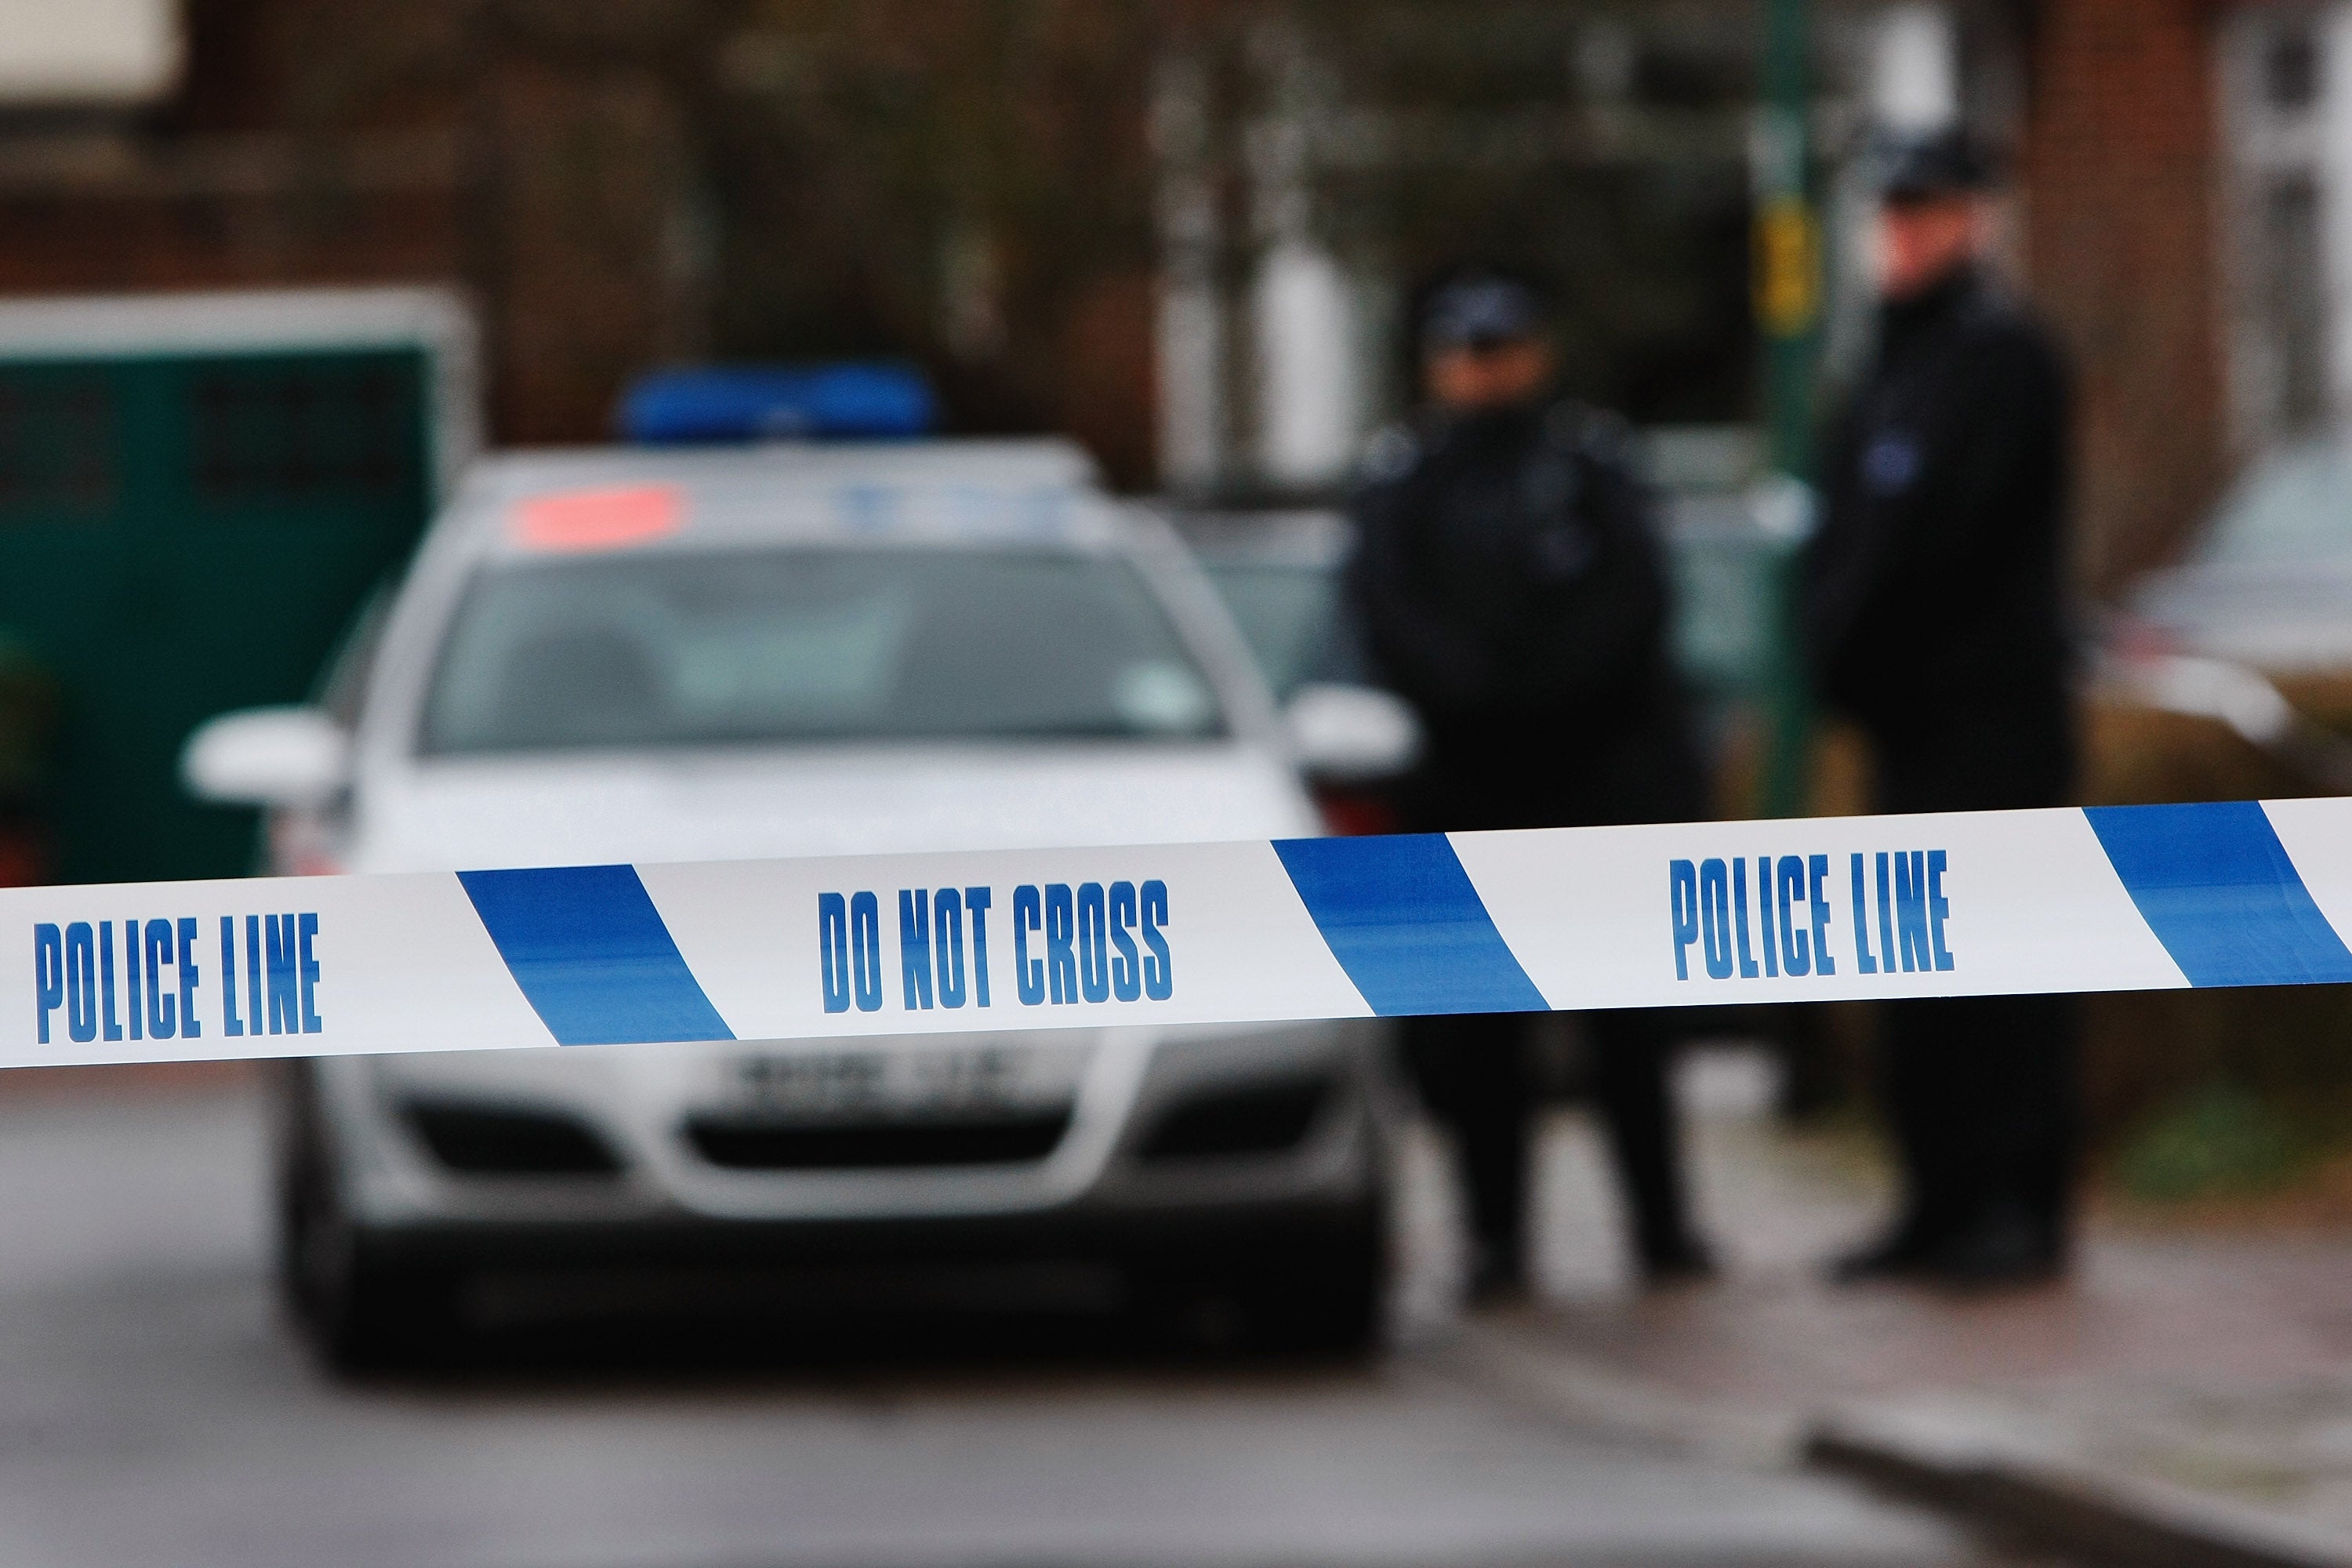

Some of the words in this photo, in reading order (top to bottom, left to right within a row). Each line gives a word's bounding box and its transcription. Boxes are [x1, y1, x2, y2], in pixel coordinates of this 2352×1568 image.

[34, 916, 201, 1044] POLICE
[220, 912, 323, 1036] LINE
[818, 890, 884, 1013] DO
[898, 885, 992, 1010] NOT
[1013, 879, 1173, 1006] CROSS
[1669, 853, 1835, 981] POLICE
[1850, 848, 1955, 975] LINE
